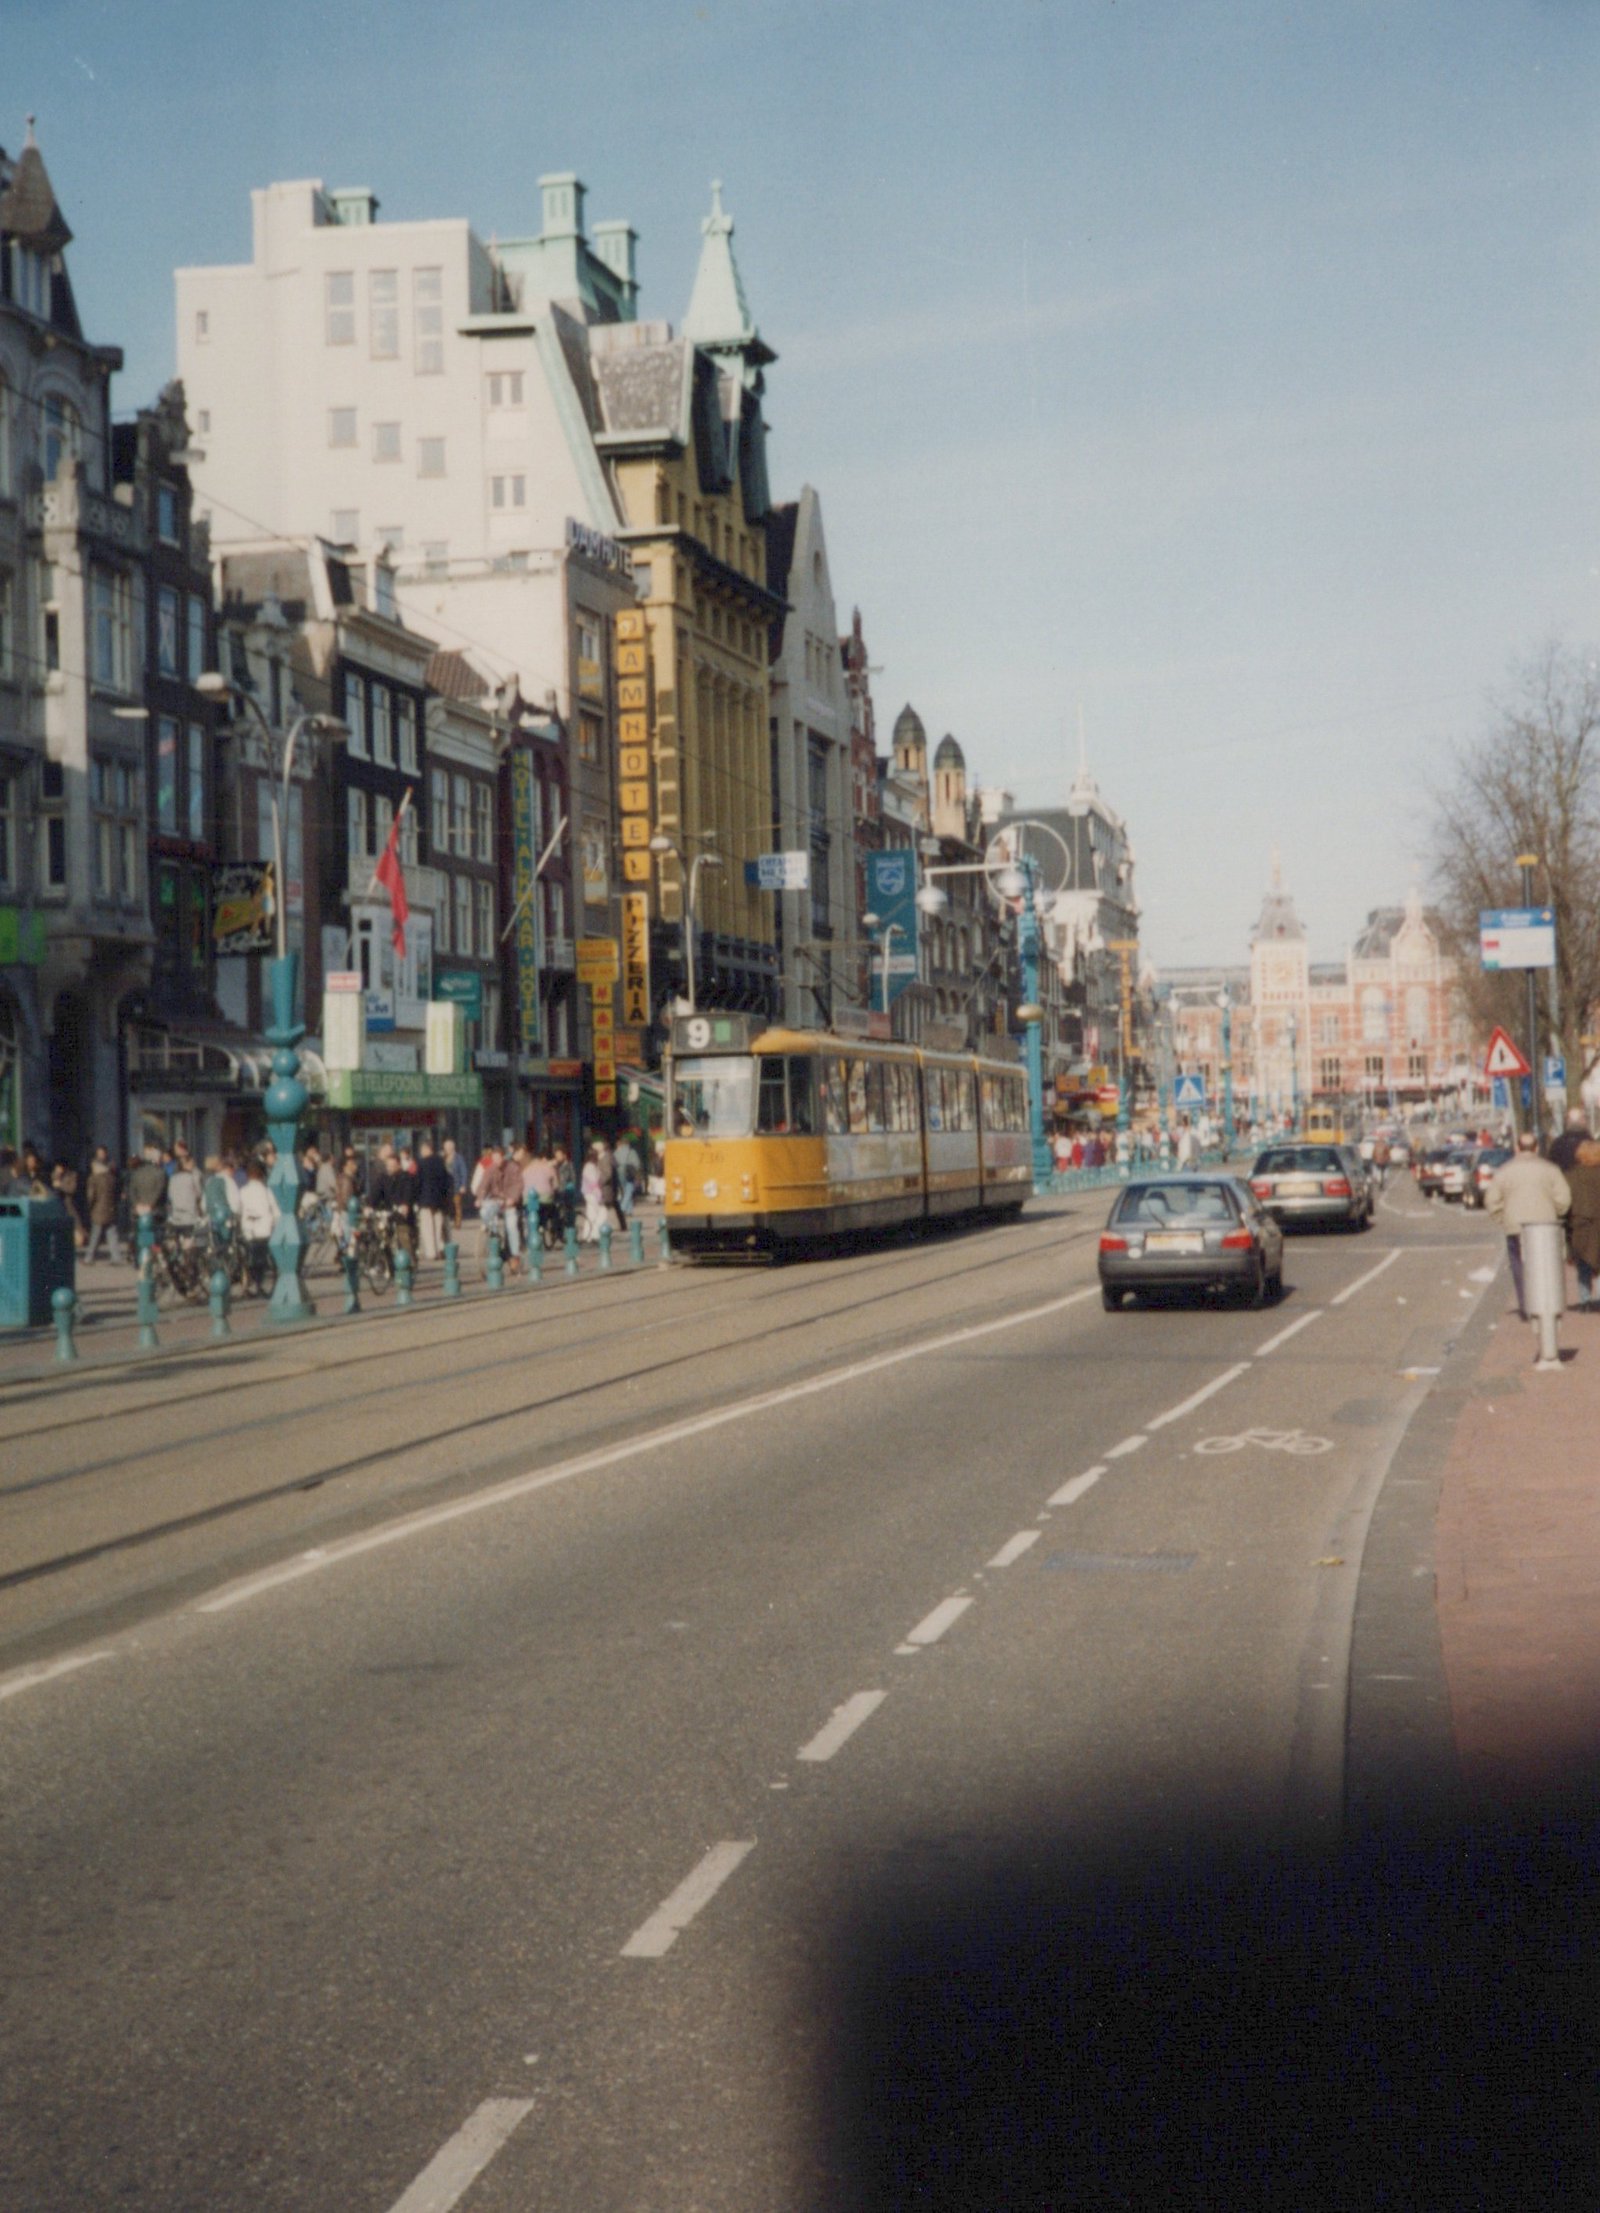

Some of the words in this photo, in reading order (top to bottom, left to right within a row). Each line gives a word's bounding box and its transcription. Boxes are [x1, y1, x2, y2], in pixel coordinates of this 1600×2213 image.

[514, 753, 530, 834] HOTEL
[626, 896, 646, 1021] PIZZERIA
[519, 967, 536, 1041] HOTEL
[687, 1017, 710, 1050] 9
[1548, 1060, 1563, 1079] P
